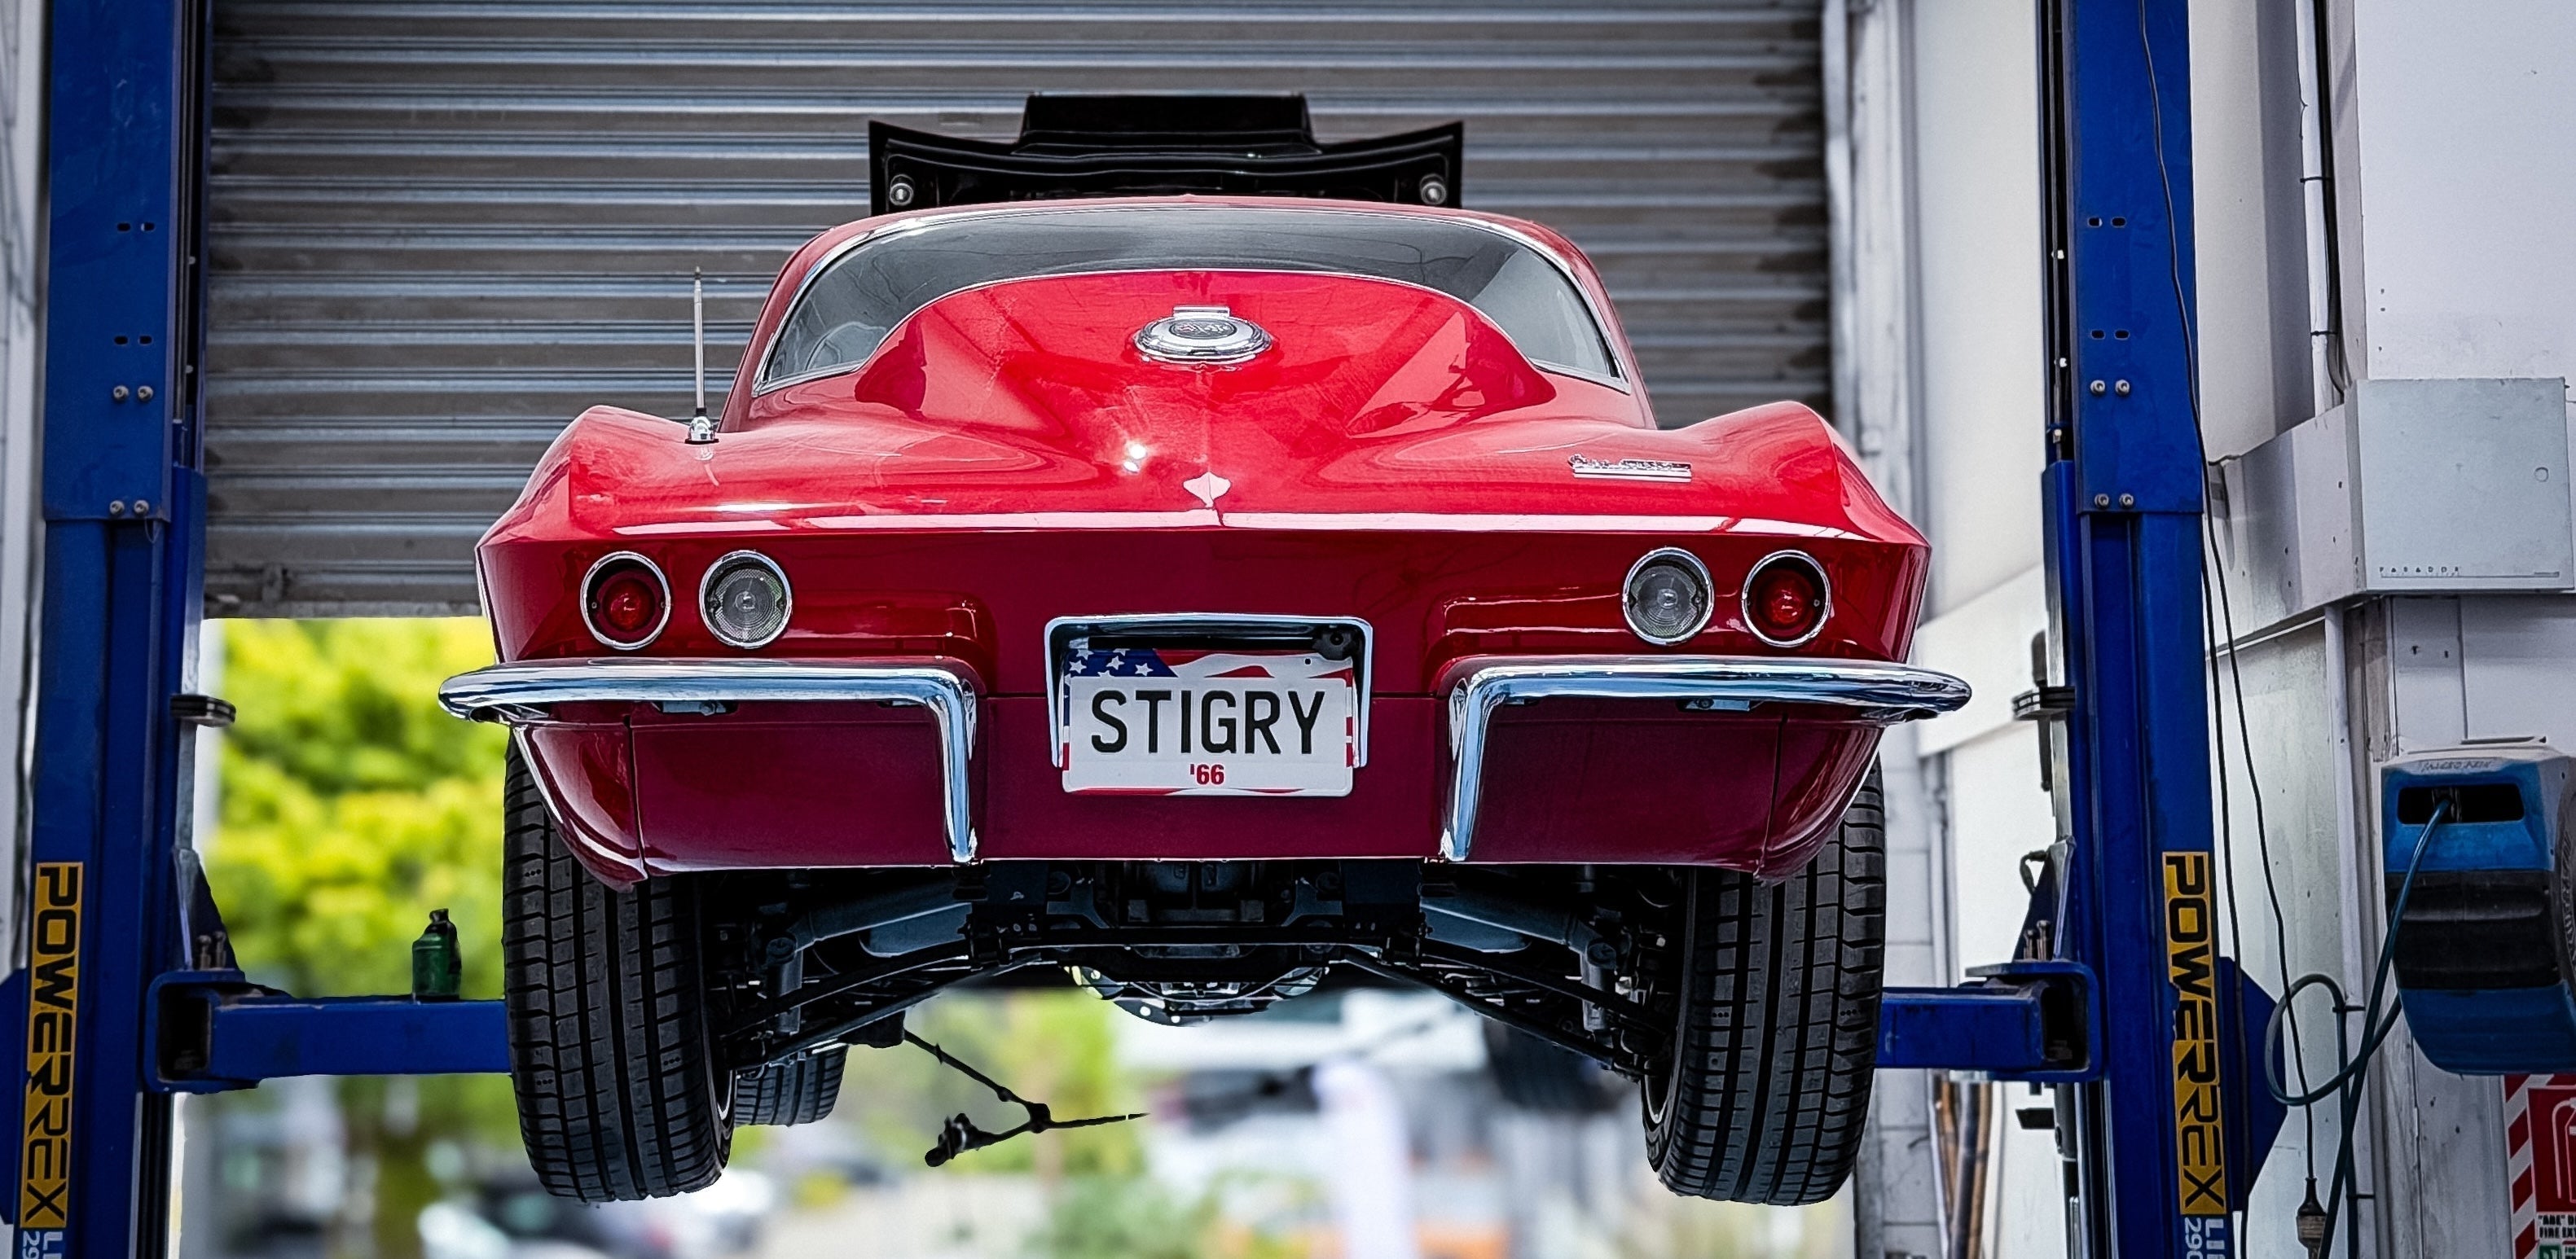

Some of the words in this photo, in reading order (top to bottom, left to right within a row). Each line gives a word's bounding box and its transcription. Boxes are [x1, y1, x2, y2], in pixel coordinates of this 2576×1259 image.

[1091, 689, 1326, 755] STIGRY
[1189, 764, 1225, 785] '66
[25, 866, 79, 1222] POWERREX
[2165, 855, 2224, 1209] POWERREX
[2539, 1226, 2560, 1239] FIRE
